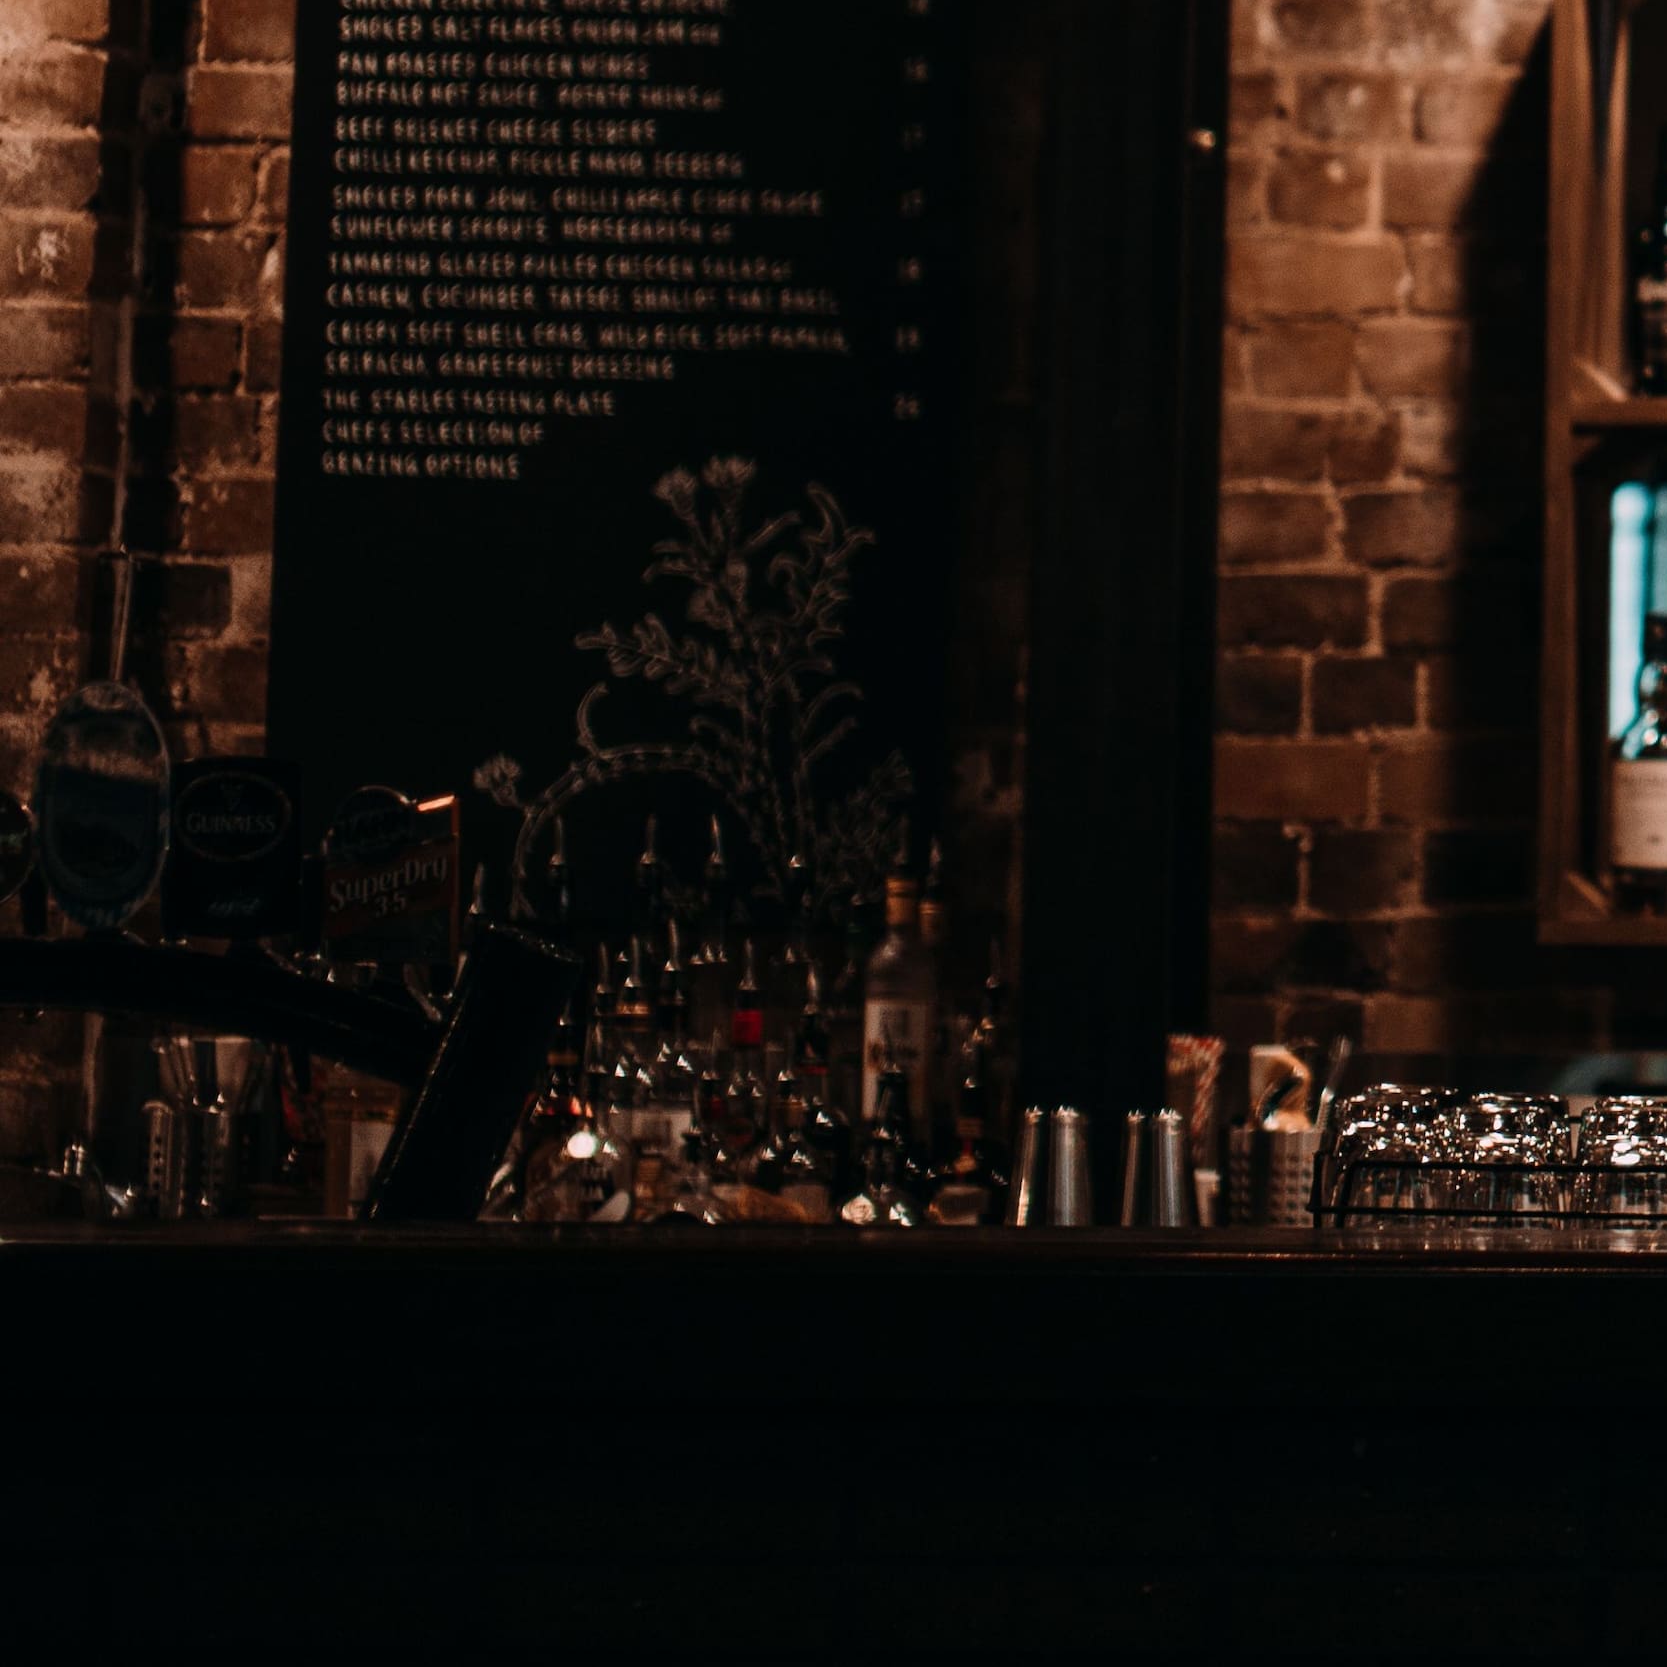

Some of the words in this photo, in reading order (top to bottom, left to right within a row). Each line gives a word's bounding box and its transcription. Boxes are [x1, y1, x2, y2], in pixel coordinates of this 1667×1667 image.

[482, 52, 575, 79] CHICKEN
[602, 254, 696, 281] CHICKEN
[186, 812, 277, 836] GUINNESS
[328, 855, 449, 914] SuperDry
